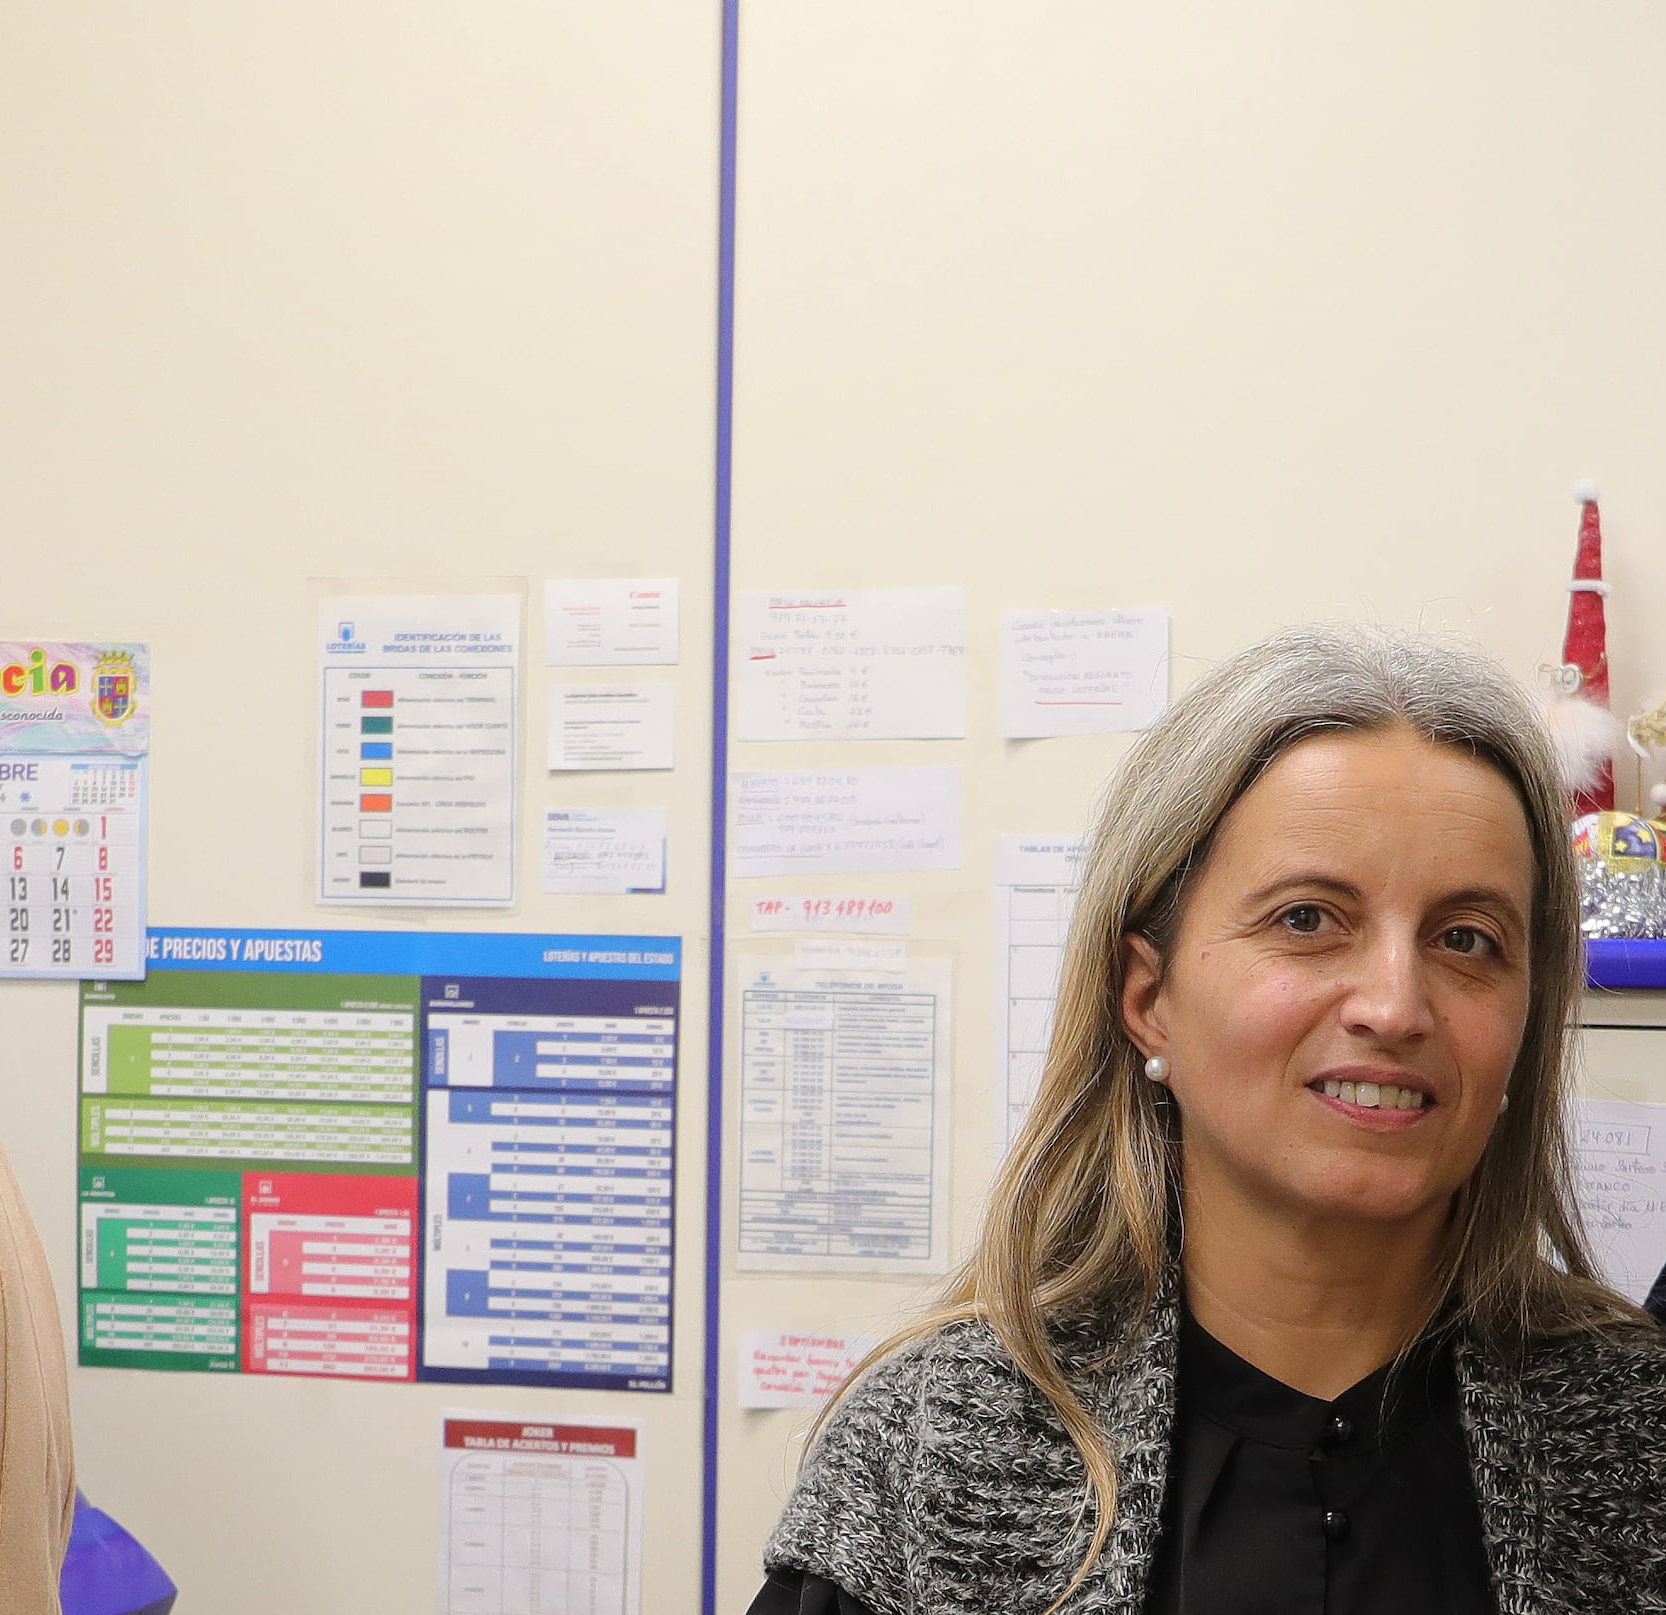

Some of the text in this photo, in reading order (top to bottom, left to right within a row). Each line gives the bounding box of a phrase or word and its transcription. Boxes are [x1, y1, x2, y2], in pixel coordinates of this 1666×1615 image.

[101, 816, 106, 839] 1
[14, 846, 22, 870] 6
[56, 846, 65, 870] 7
[99, 847, 108, 870] 8
[10, 876, 27, 901] 13
[53, 877, 69, 901] 14
[95, 878, 112, 901] 15
[10, 908, 28, 931] 20
[53, 909, 70, 931] 21
[95, 909, 113, 932] 22
[10, 939, 28, 962] 27
[53, 939, 71, 963] 28
[95, 939, 113, 963] 29
[163, 938, 227, 960] PRECIOS
[230, 939, 241, 959] Y
[244, 939, 322, 963] APUESTAS
[544, 950, 674, 965] LOTERÍAS Y APUESTAS DEL ESTADO
